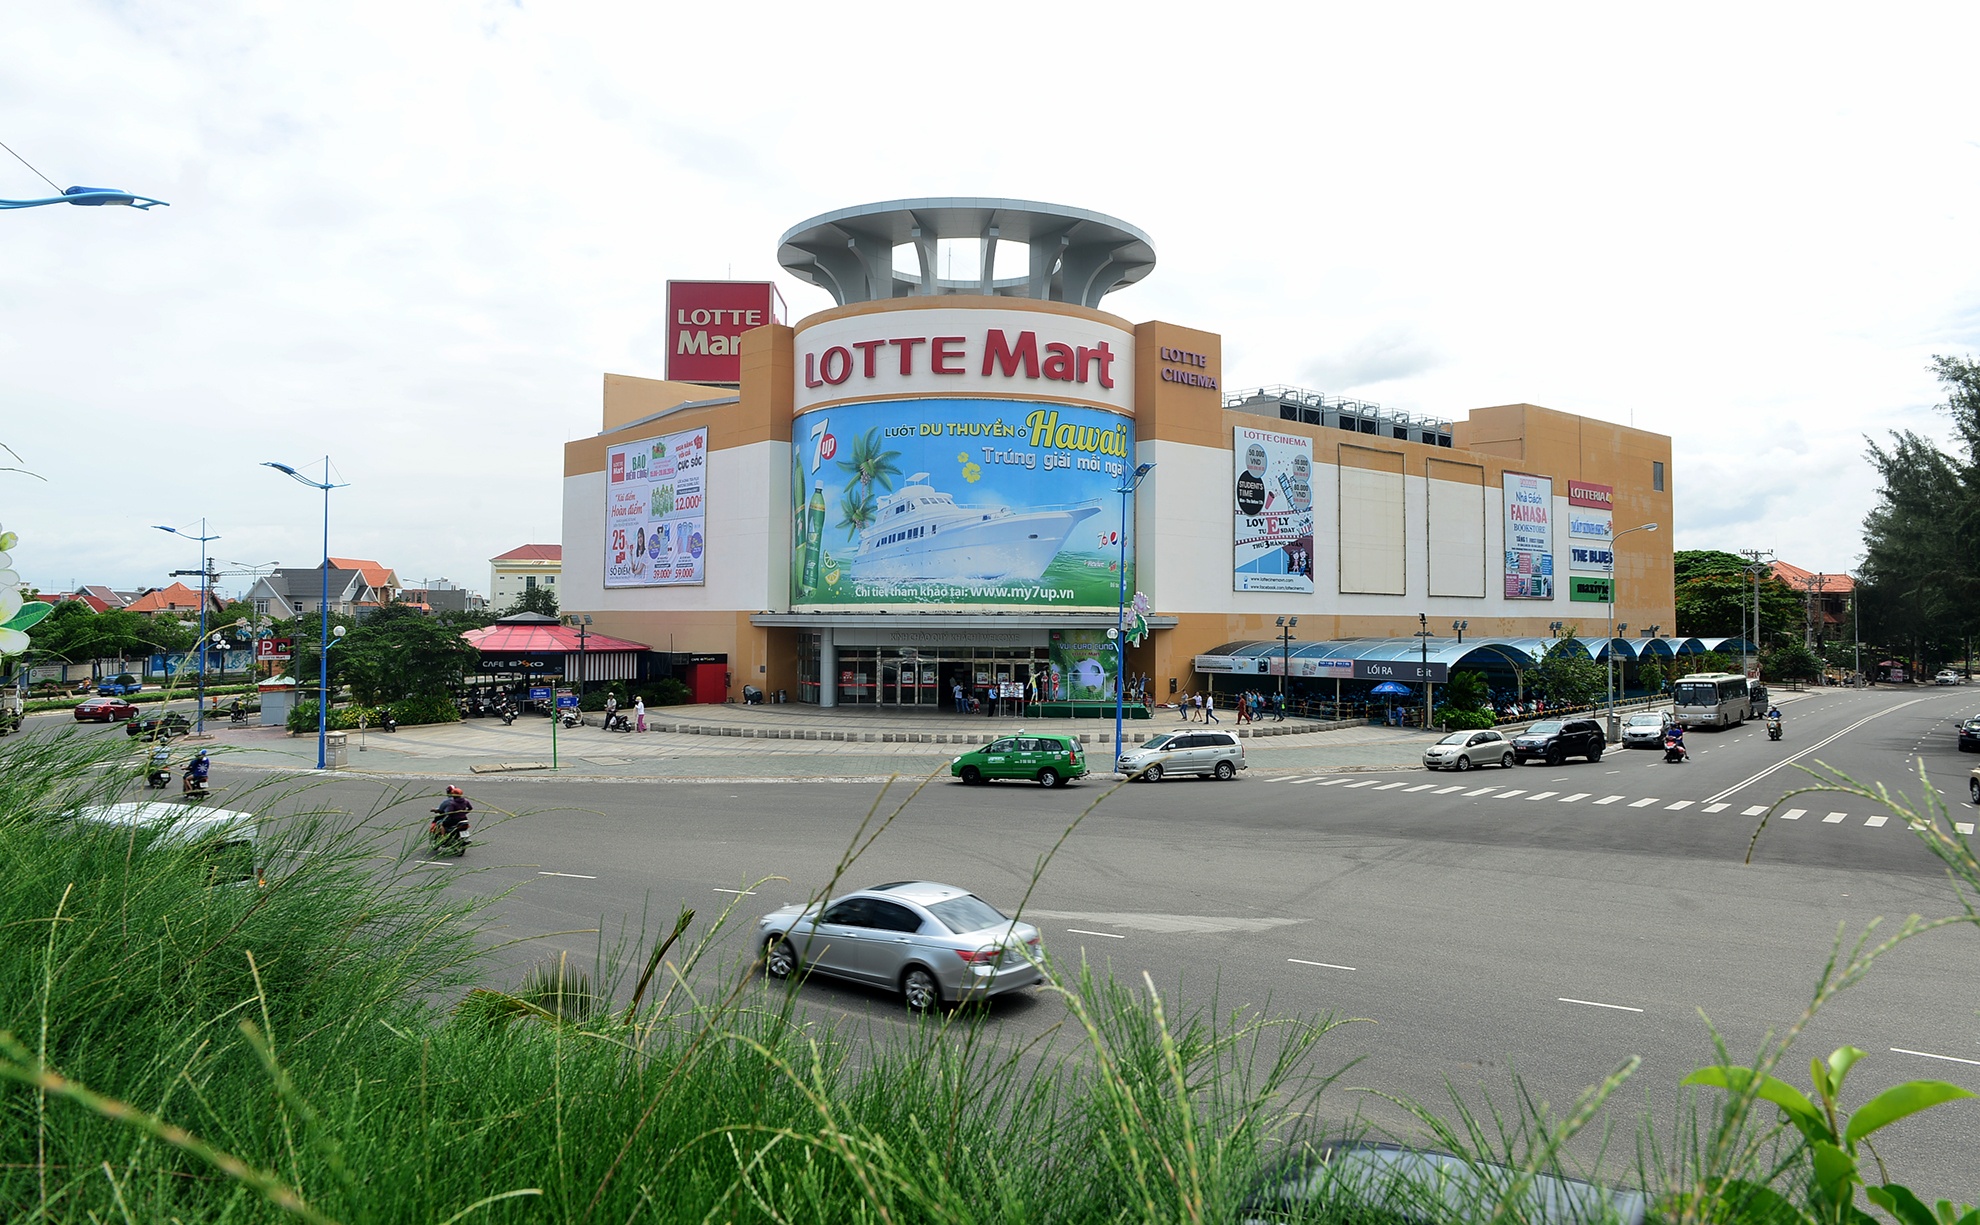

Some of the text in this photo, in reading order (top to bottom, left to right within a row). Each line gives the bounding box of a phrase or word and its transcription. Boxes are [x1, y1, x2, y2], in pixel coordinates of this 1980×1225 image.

[677, 308, 761, 326] LOTTE
[677, 330, 741, 356] Mar
[804, 328, 1115, 389] LOTTE Mart
[1161, 346, 1207, 368] LOTTE
[1161, 367, 1218, 390] CINEMA
[919, 423, 942, 437] DU
[946, 418, 1015, 438] THUYỀN
[1025, 409, 1129, 458] Hawaii
[1244, 430, 1307, 447] LOTTE CINEMA
[982, 446, 1036, 469] Trúng
[1043, 451, 1071, 471] giải
[1077, 453, 1100, 472] mỗi
[1239, 489, 1253, 497] TIME
[1570, 487, 1606, 502] LOTTERIA
[1510, 503, 1548, 524] FAHASA
[1513, 523, 1546, 534] BOOKSTORE
[1572, 548, 1613, 564] THE BLUES
[854, 586, 871, 597] Chi
[871, 585, 890, 597] tiết
[890, 586, 918, 597] tham
[919, 585, 948, 597] khảo
[970, 585, 1075, 601] www.my7up.vn
[982, 633, 1020, 641] WELCOME
[1381, 666, 1393, 675] RA
